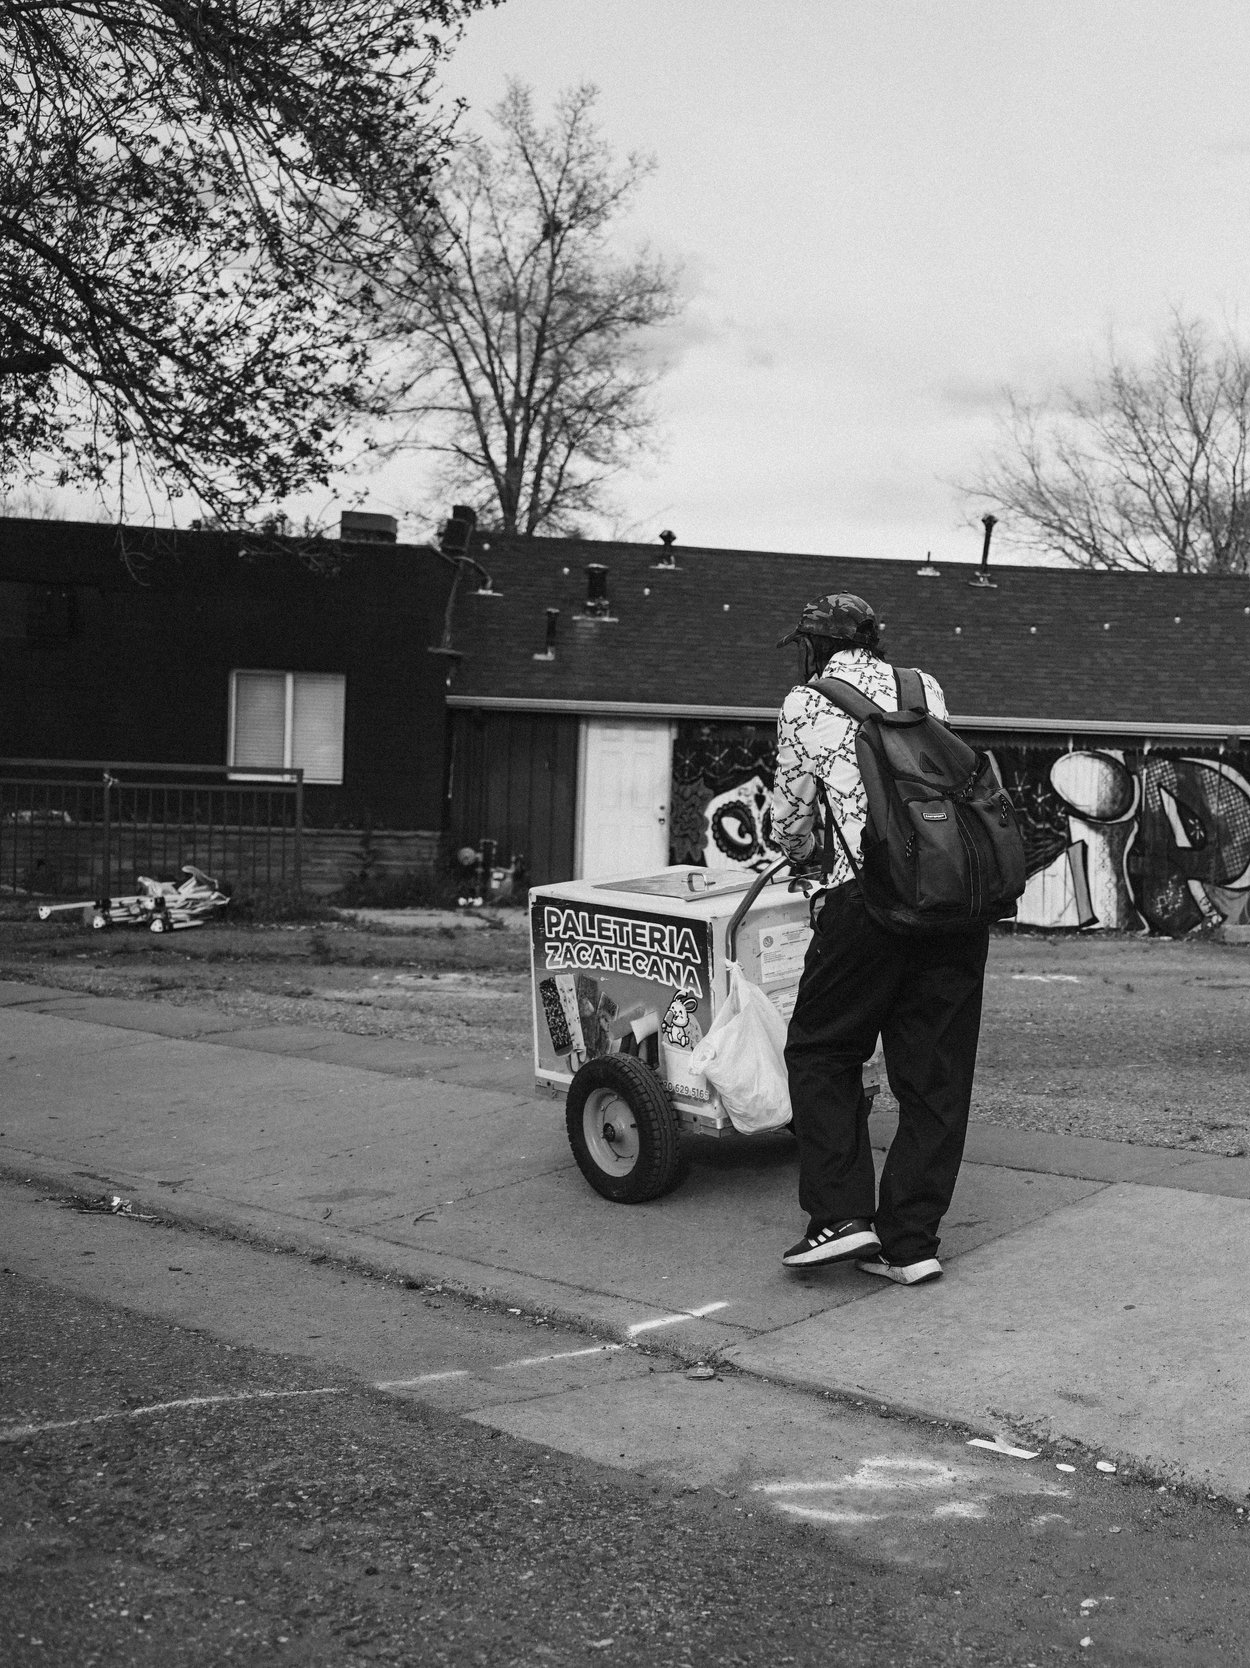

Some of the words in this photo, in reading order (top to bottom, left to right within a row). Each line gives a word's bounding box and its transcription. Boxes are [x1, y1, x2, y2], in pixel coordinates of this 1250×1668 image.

[544, 906, 702, 964] PALETERIA
[545, 942, 703, 999] ZACATECANA
[674, 1083, 690, 1096] 629
